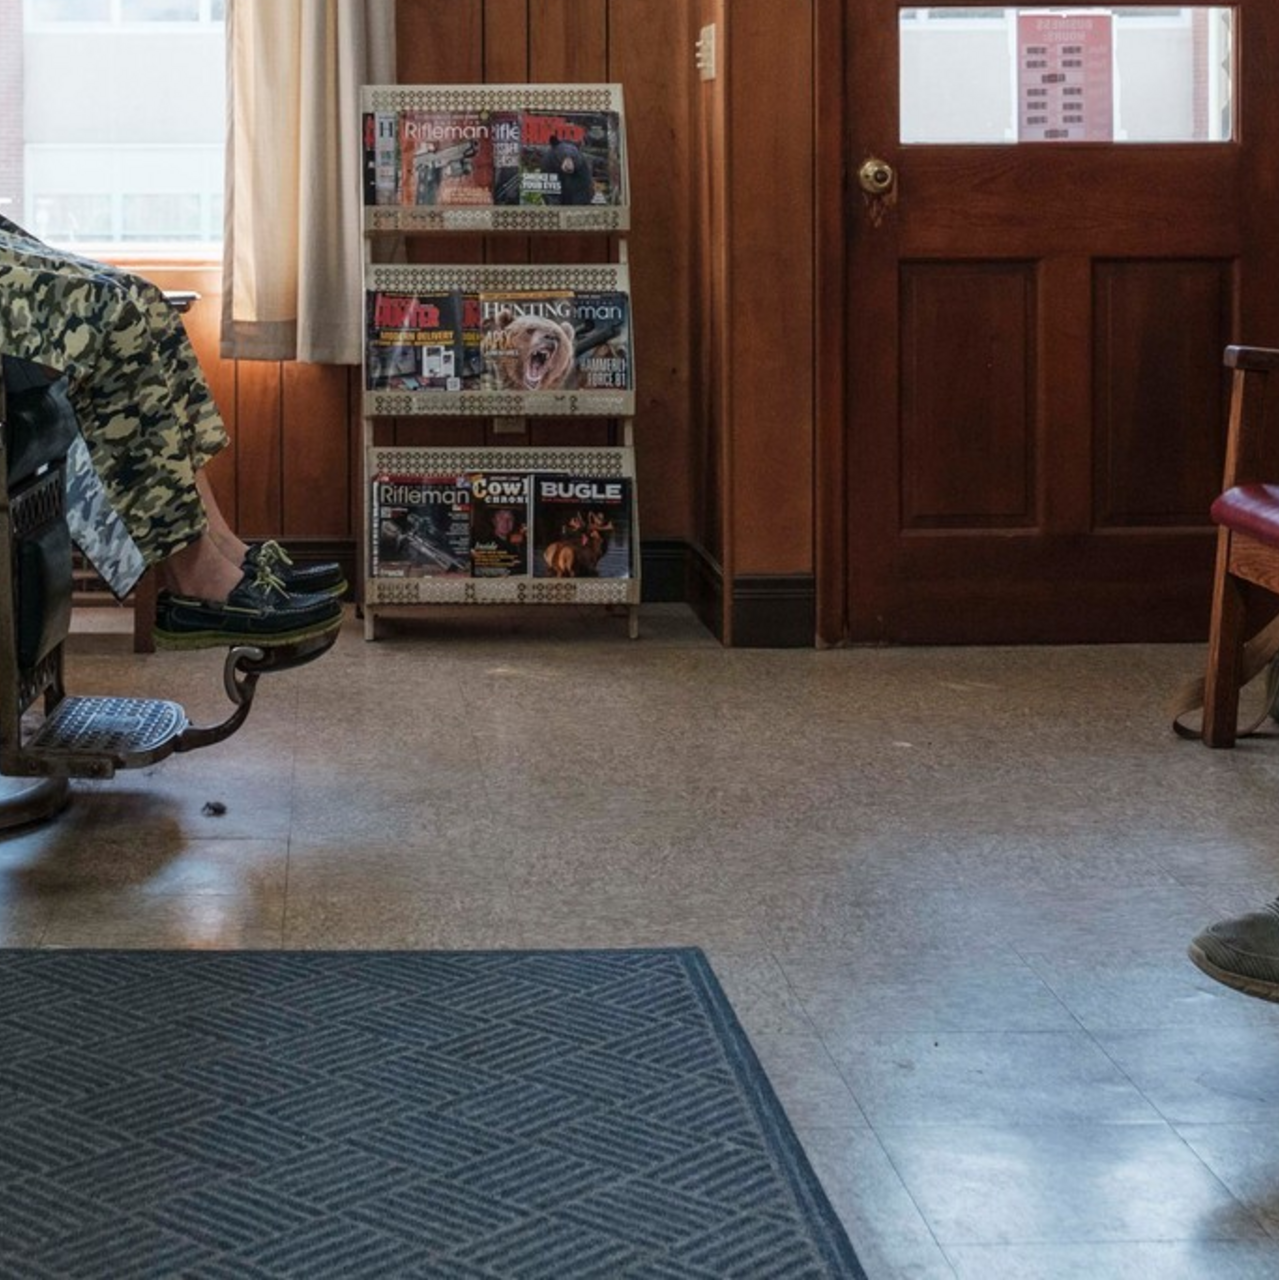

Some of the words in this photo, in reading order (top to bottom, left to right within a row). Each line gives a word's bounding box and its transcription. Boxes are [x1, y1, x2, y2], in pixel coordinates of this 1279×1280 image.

[405, 121, 489, 139] Rifleman
[483, 301, 571, 319] HUNTING
[381, 485, 470, 504] Rifleman
[540, 481, 623, 499] BUGLE
